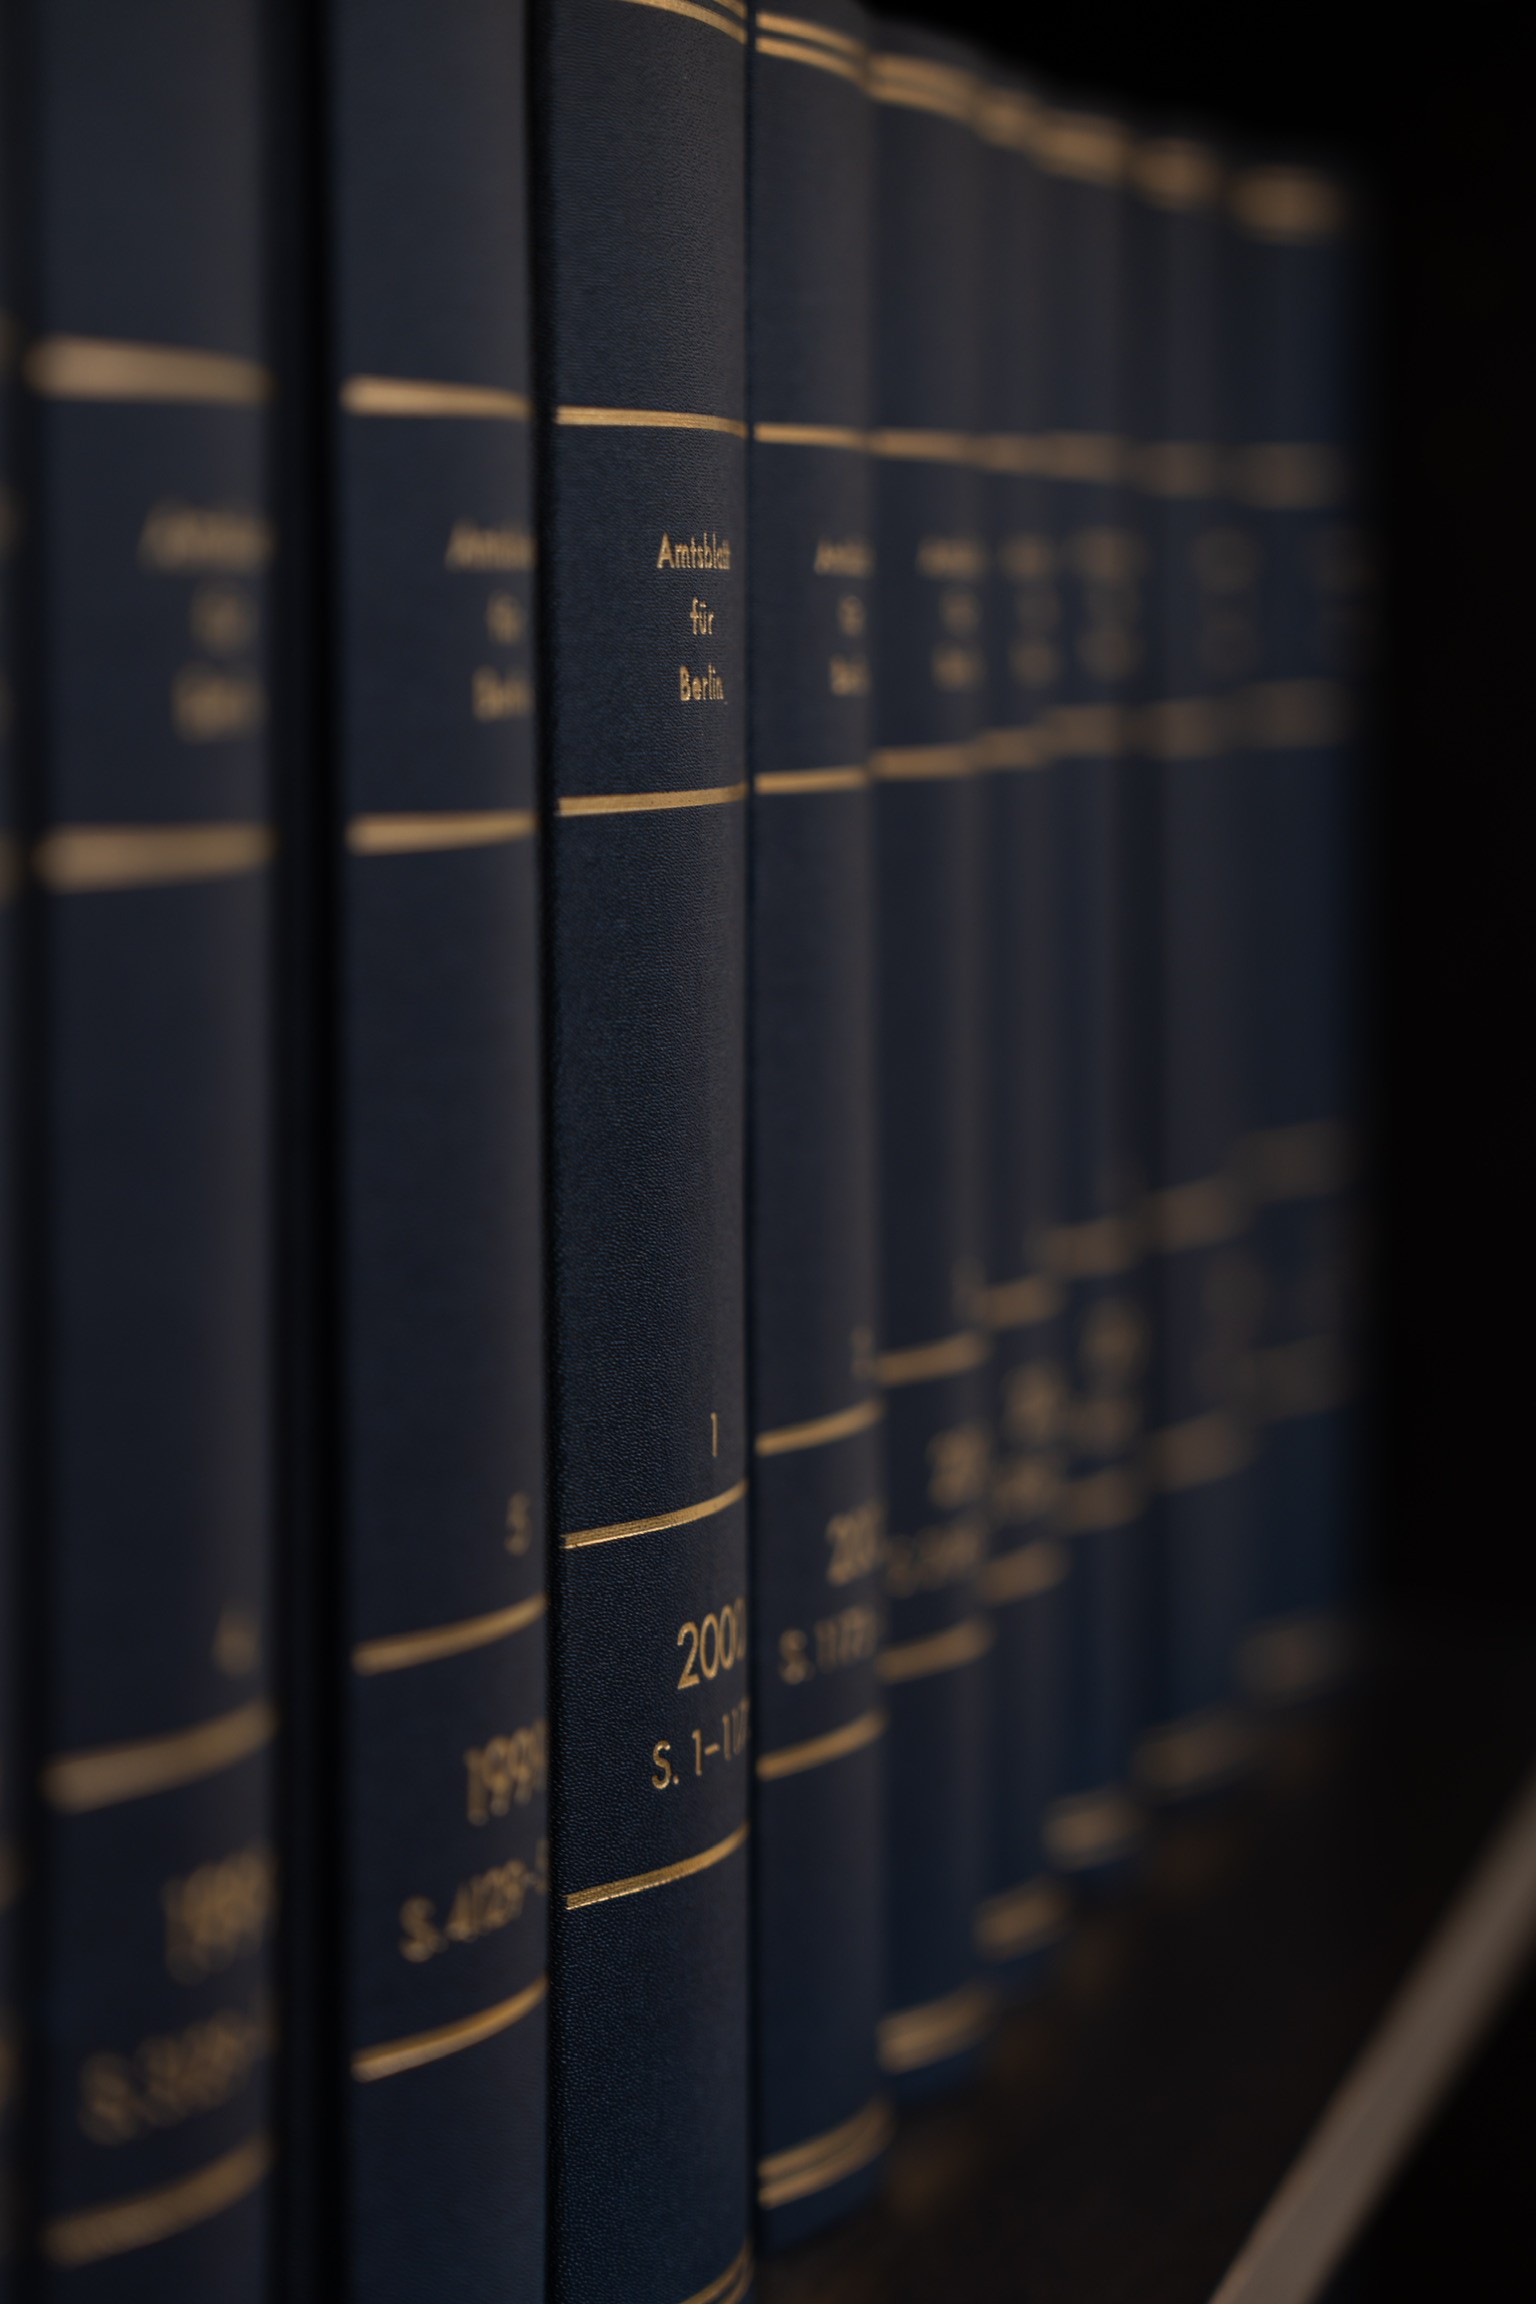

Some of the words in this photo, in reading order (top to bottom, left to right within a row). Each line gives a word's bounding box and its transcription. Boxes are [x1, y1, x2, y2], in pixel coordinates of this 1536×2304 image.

[689, 597, 714, 635] für
[679, 664, 724, 701] Berlin
[710, 1411, 719, 1458] 1
[650, 1737, 681, 1790] S.
